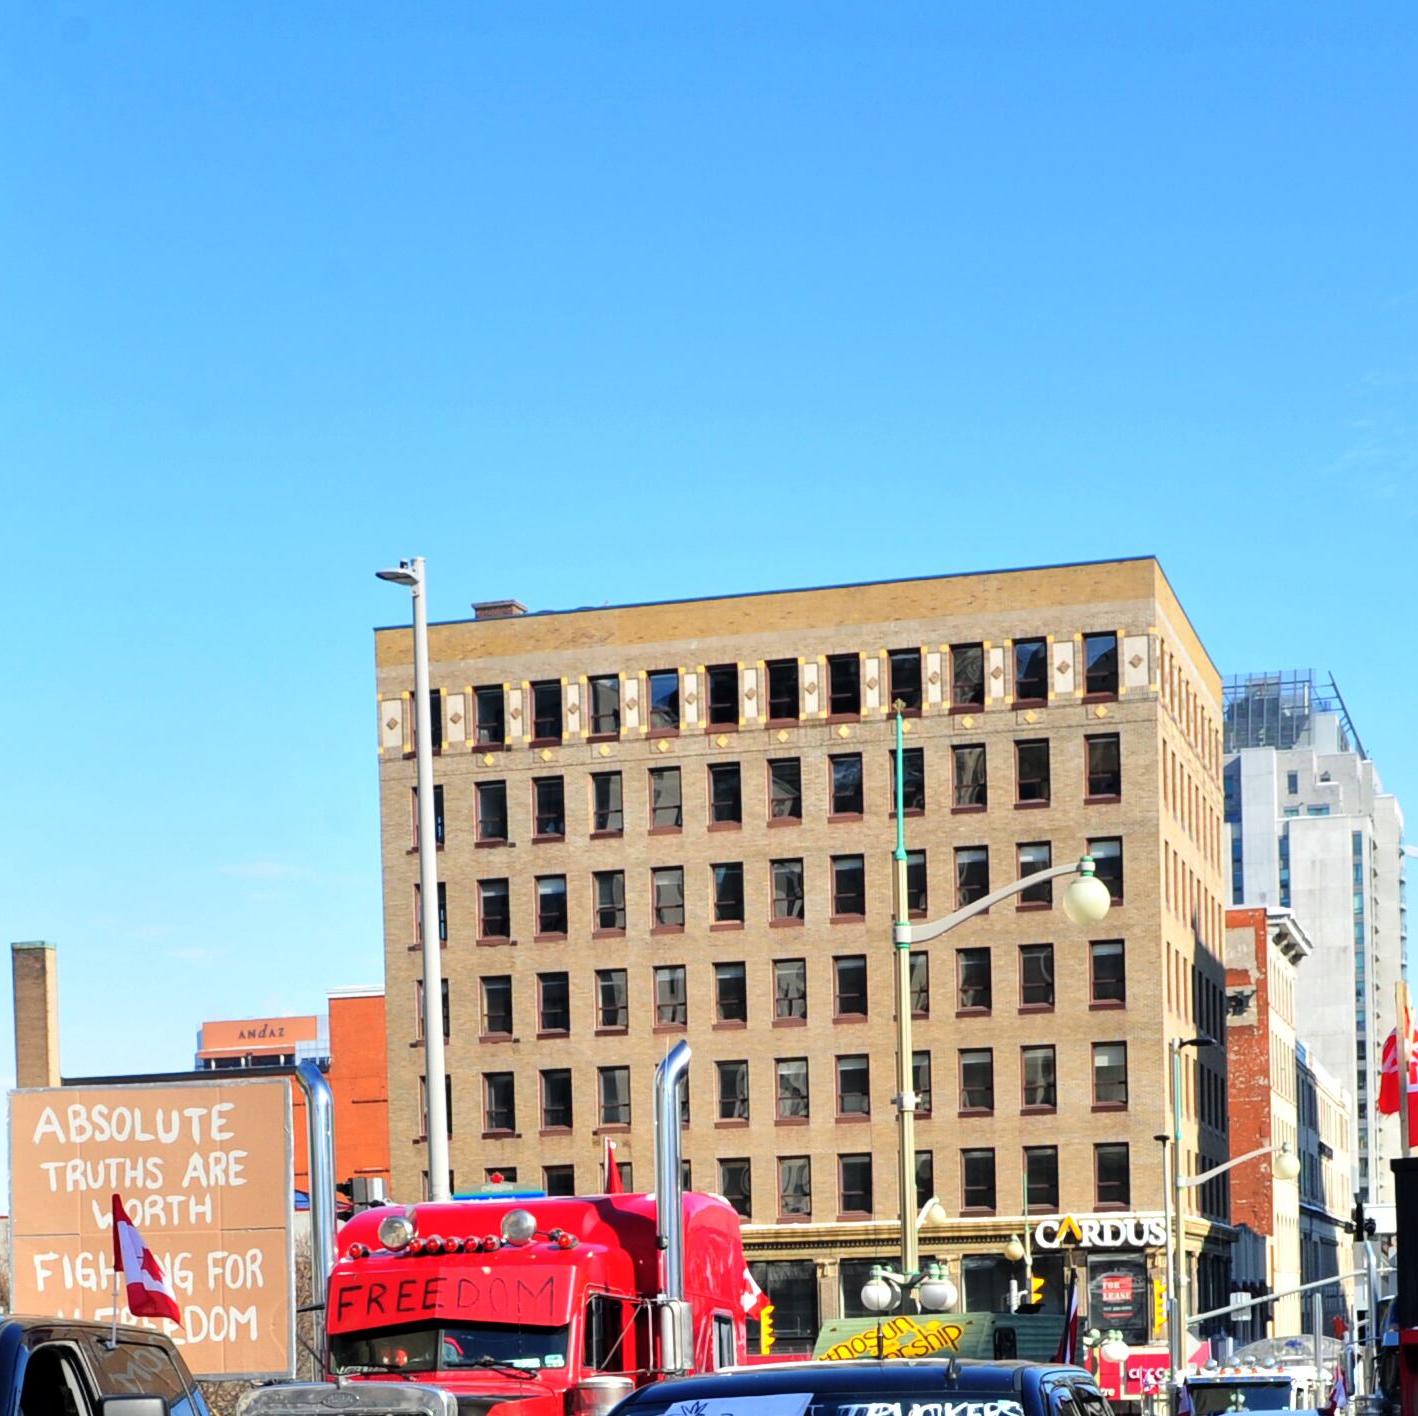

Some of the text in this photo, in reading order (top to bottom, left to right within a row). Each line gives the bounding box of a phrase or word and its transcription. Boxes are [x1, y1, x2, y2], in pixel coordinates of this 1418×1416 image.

[33, 1102, 235, 1145] ABSOLUTE
[40, 1150, 249, 1192] TRUTHS ARE
[92, 1193, 213, 1230] WORTH
[1035, 1216, 1167, 1248] CARDUS
[33, 1248, 264, 1296] FIGHNG FOR
[336, 1276, 555, 1322] FREEDOM
[94, 1305, 258, 1346] FREDOM
